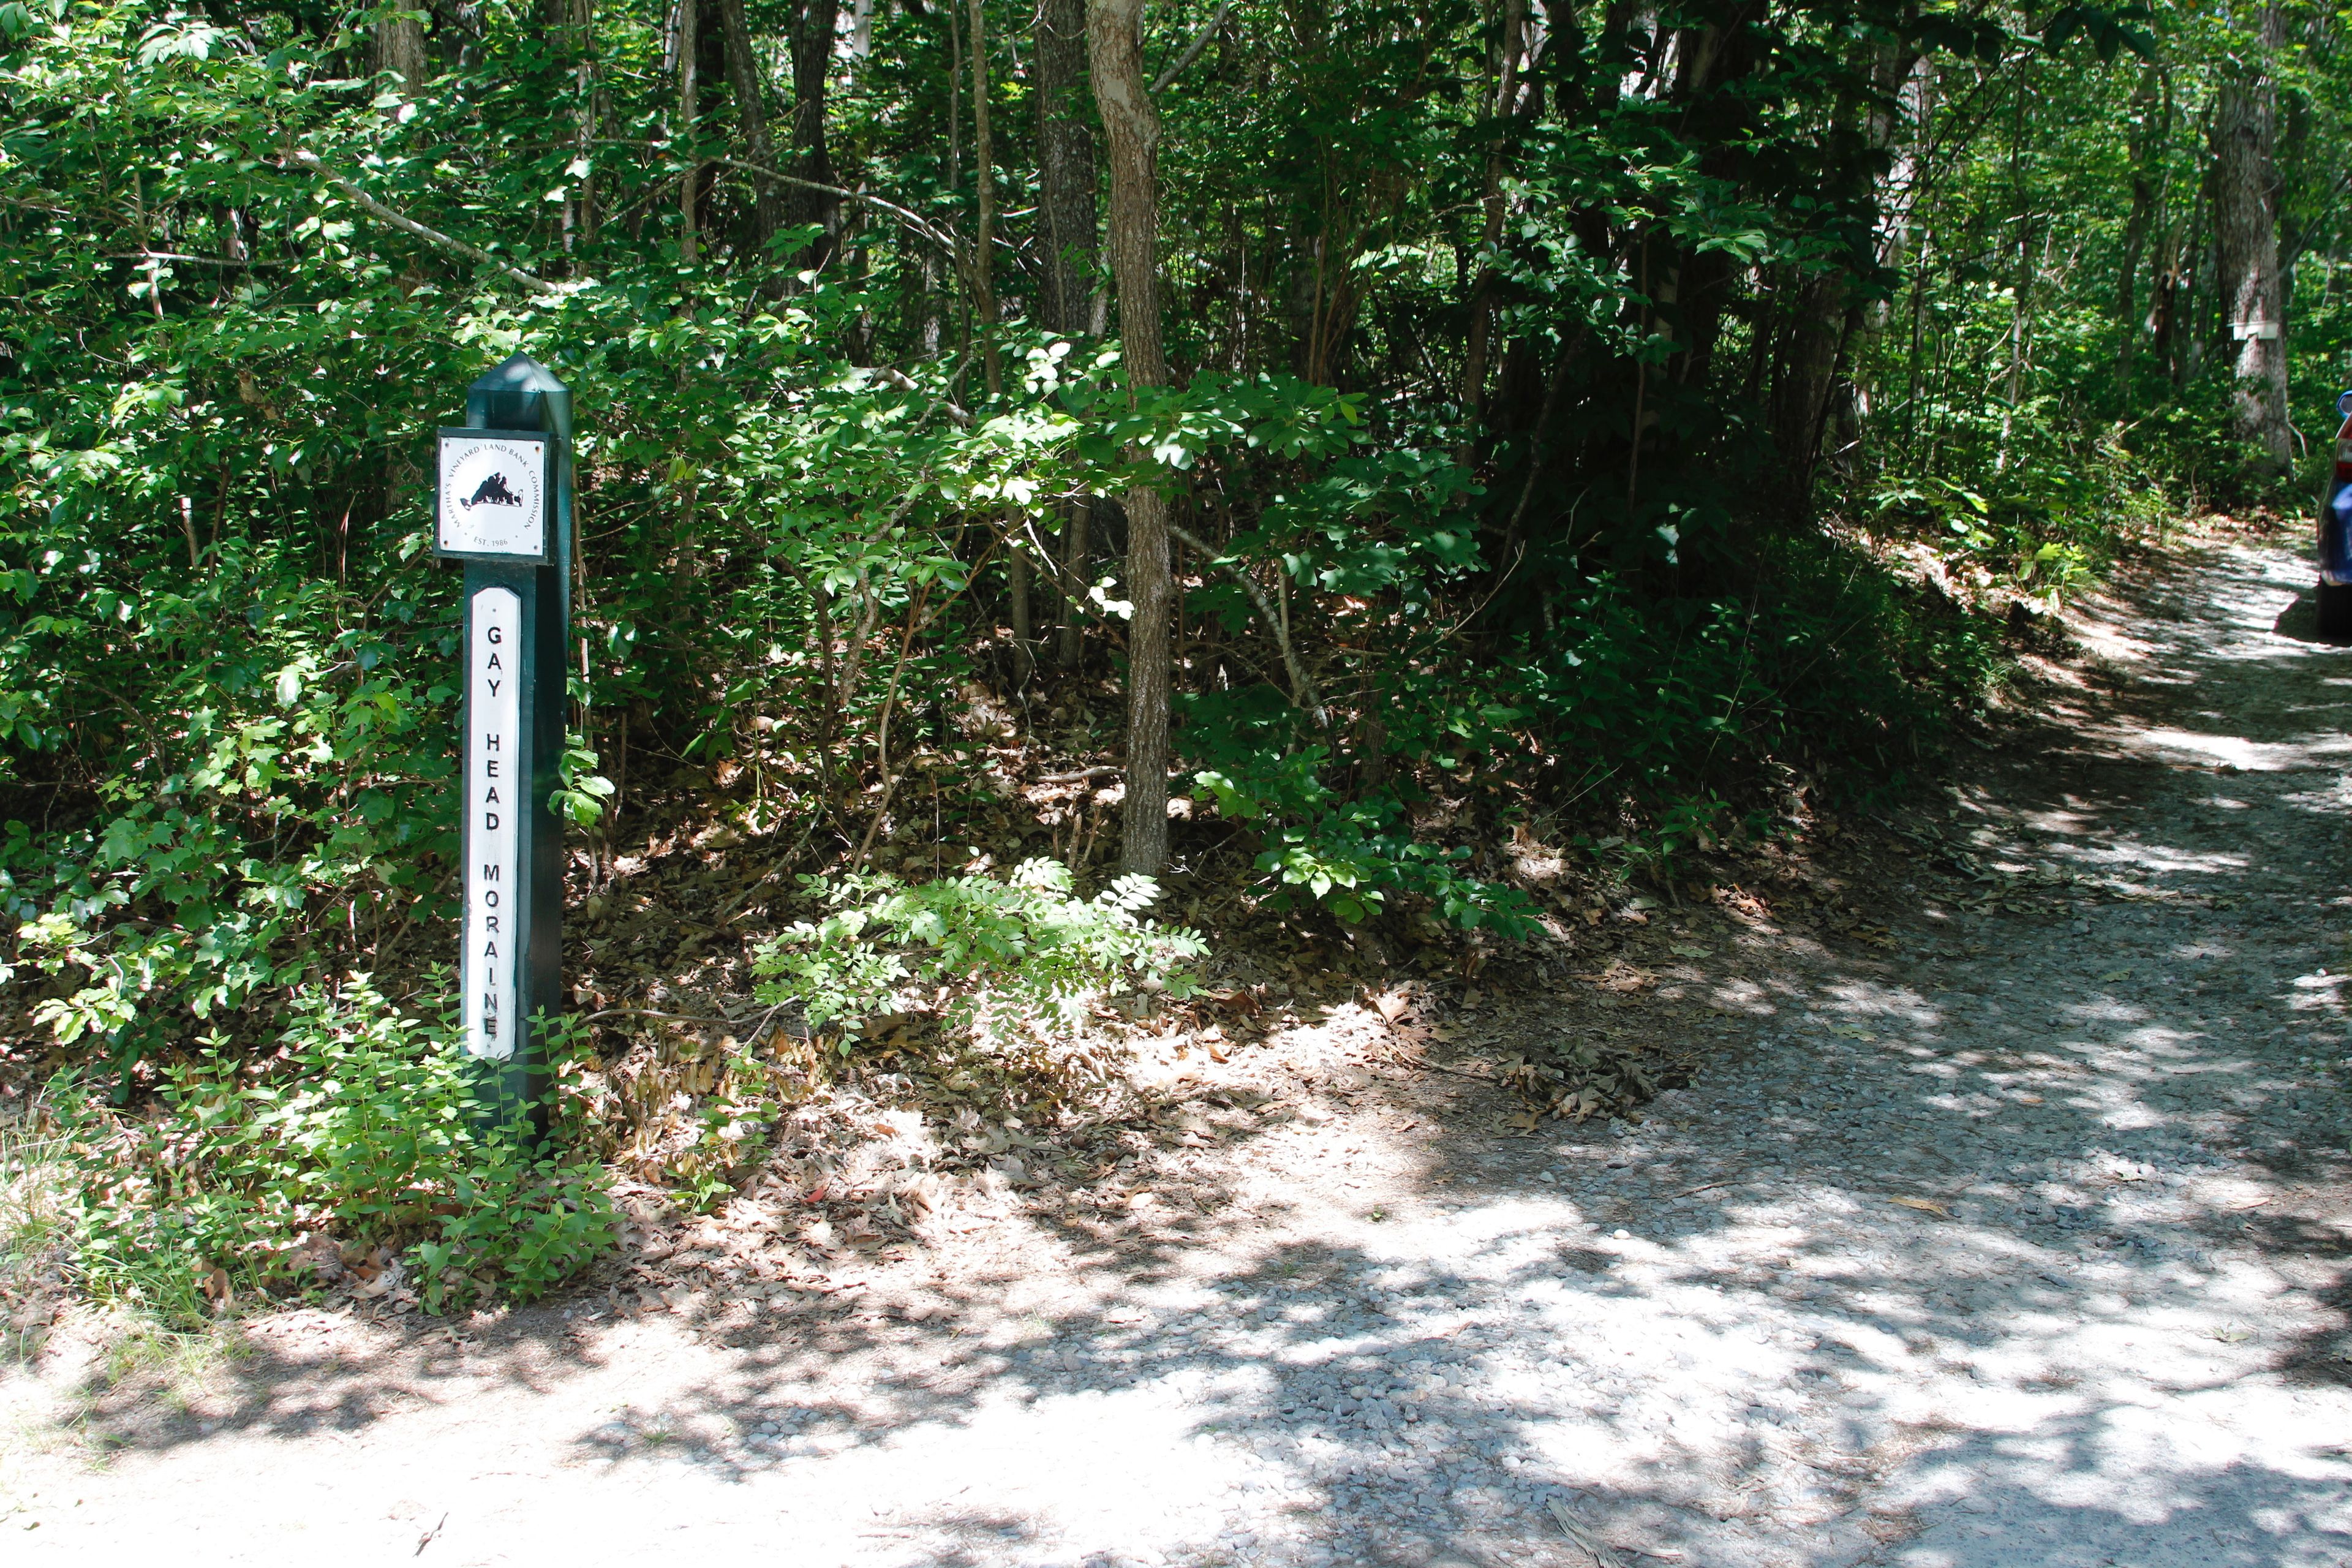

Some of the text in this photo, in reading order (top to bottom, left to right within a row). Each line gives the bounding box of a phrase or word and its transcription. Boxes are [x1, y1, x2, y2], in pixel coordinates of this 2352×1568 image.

[446, 443, 540, 530] MARTHA'S VINEYARD LAND BANK COMMISSION
[473, 537, 489, 546] EST.
[484, 627, 502, 1036] GAY HEAD MORAINE
